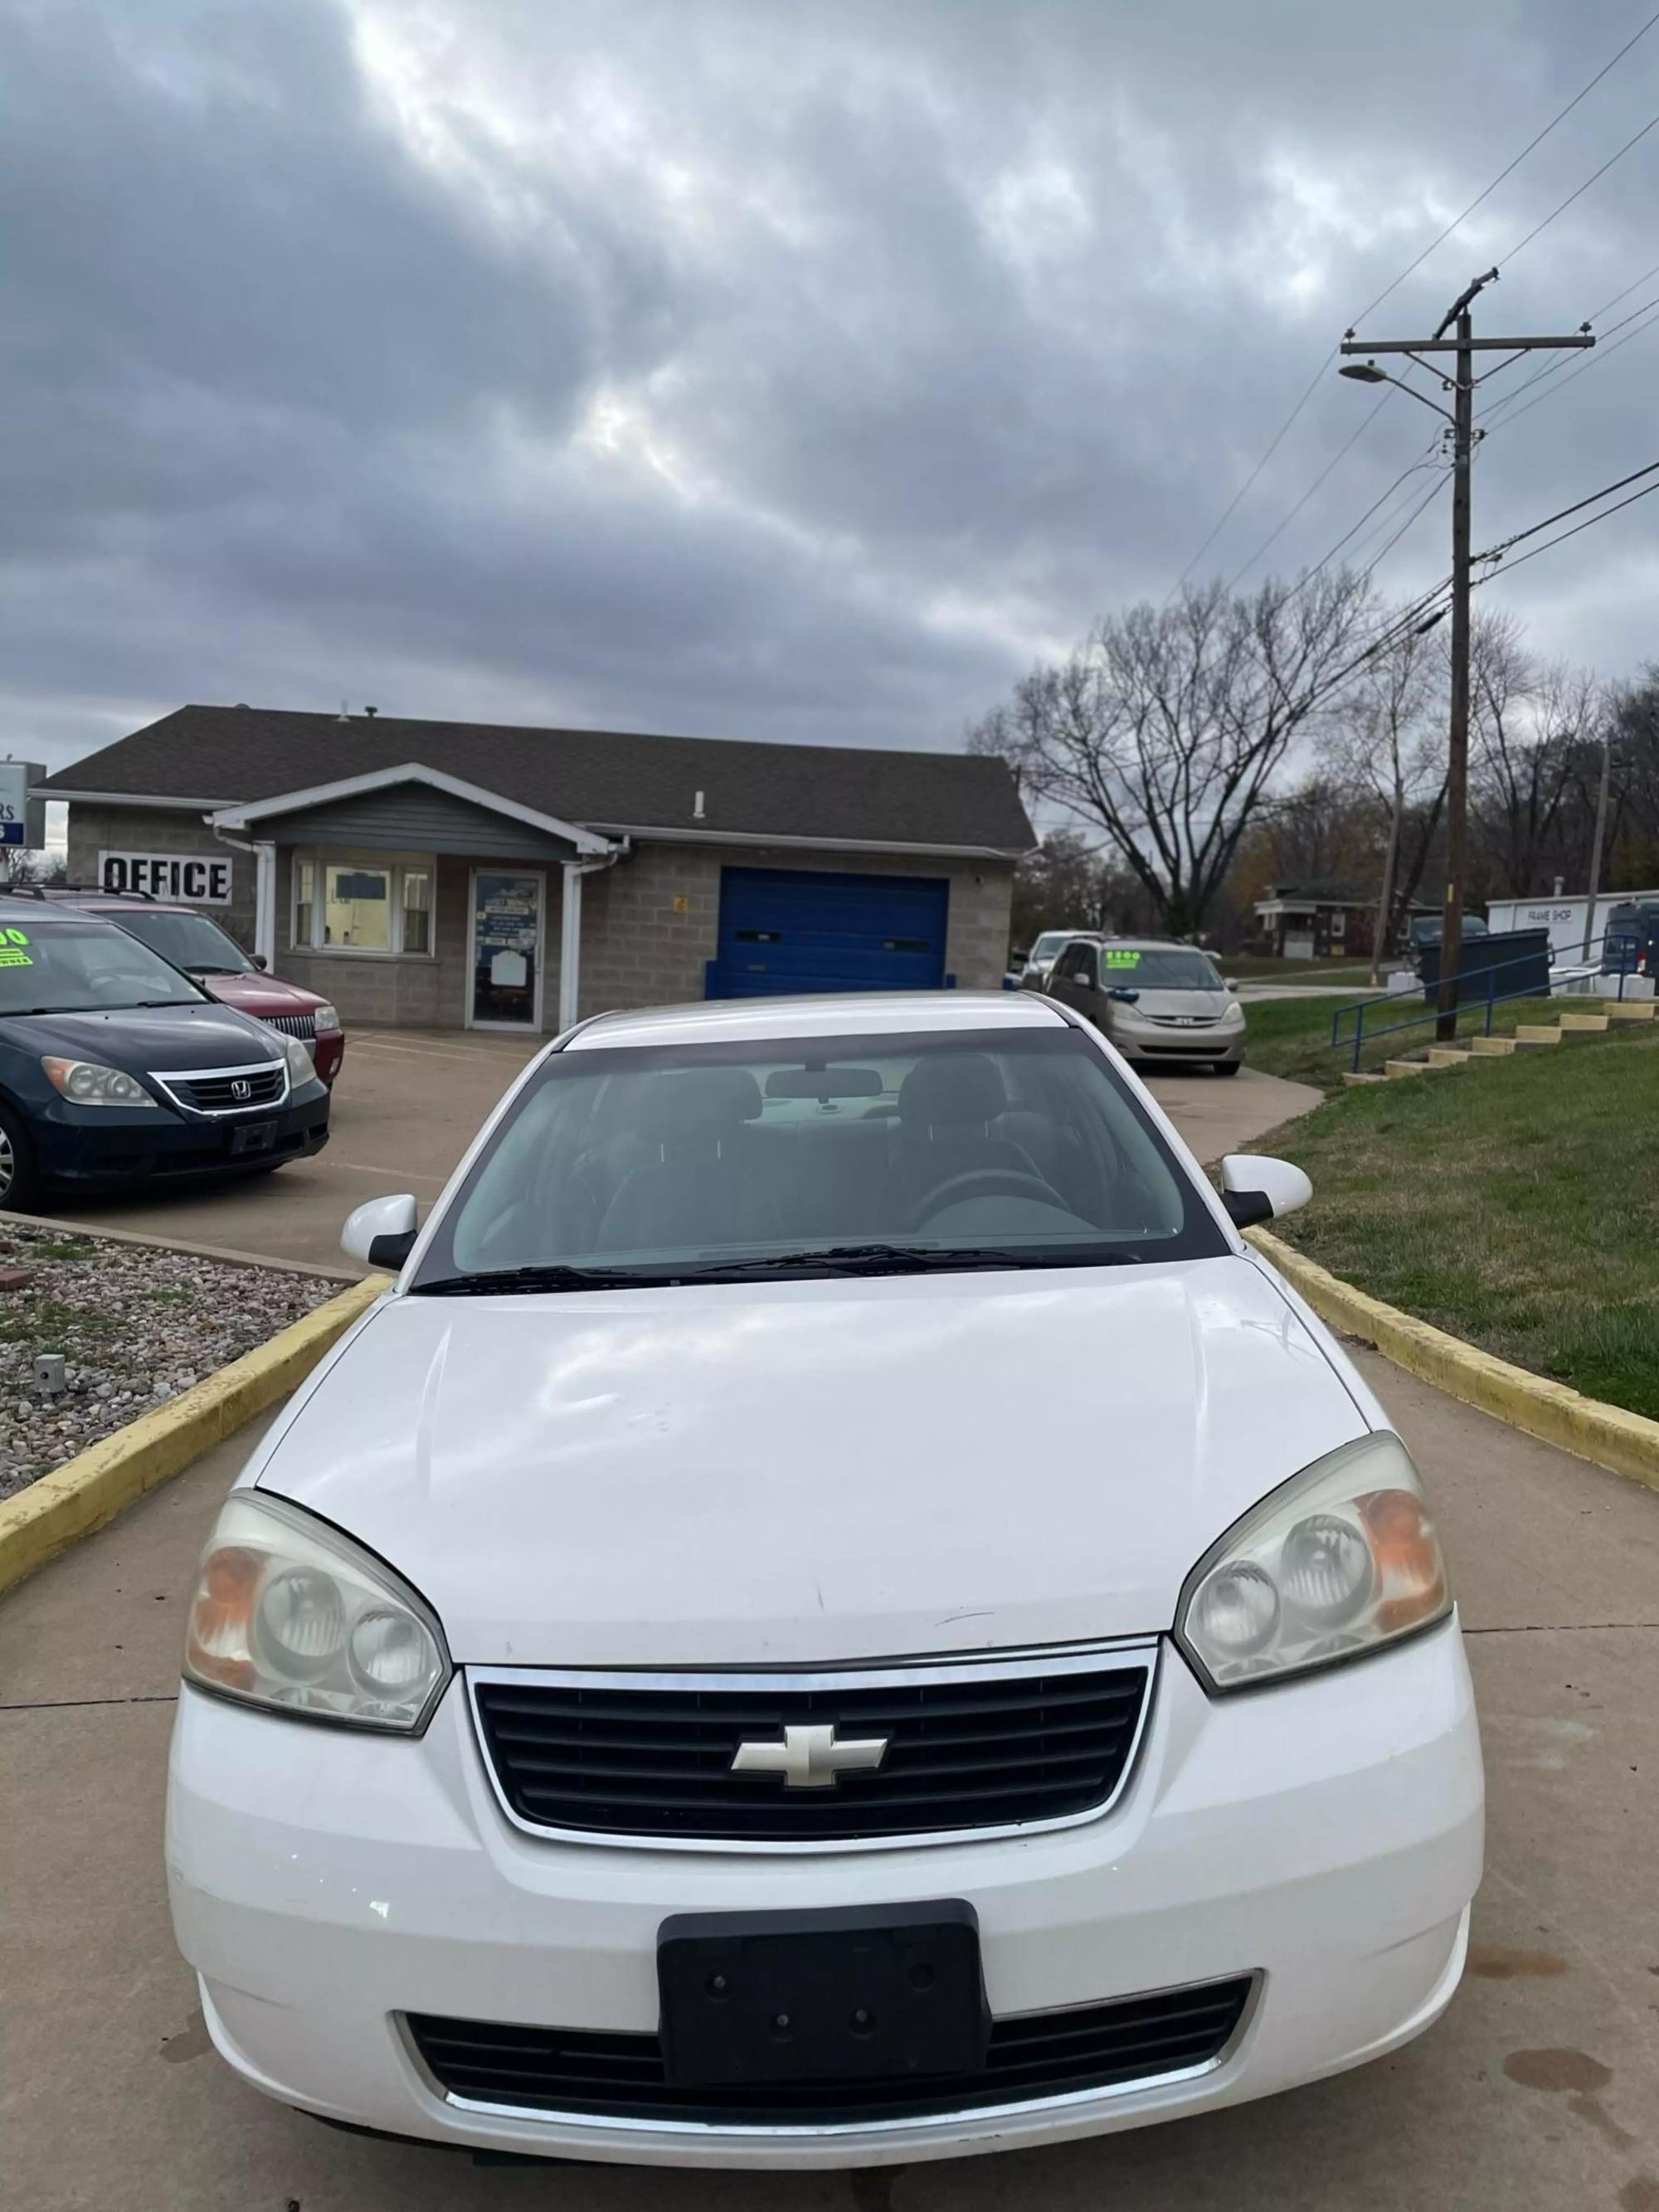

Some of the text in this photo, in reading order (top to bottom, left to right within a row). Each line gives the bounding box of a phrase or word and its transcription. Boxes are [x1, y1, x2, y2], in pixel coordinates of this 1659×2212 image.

[104, 858, 227, 899] OFFICE
[1528, 909, 1572, 921] FRAME SHOP
